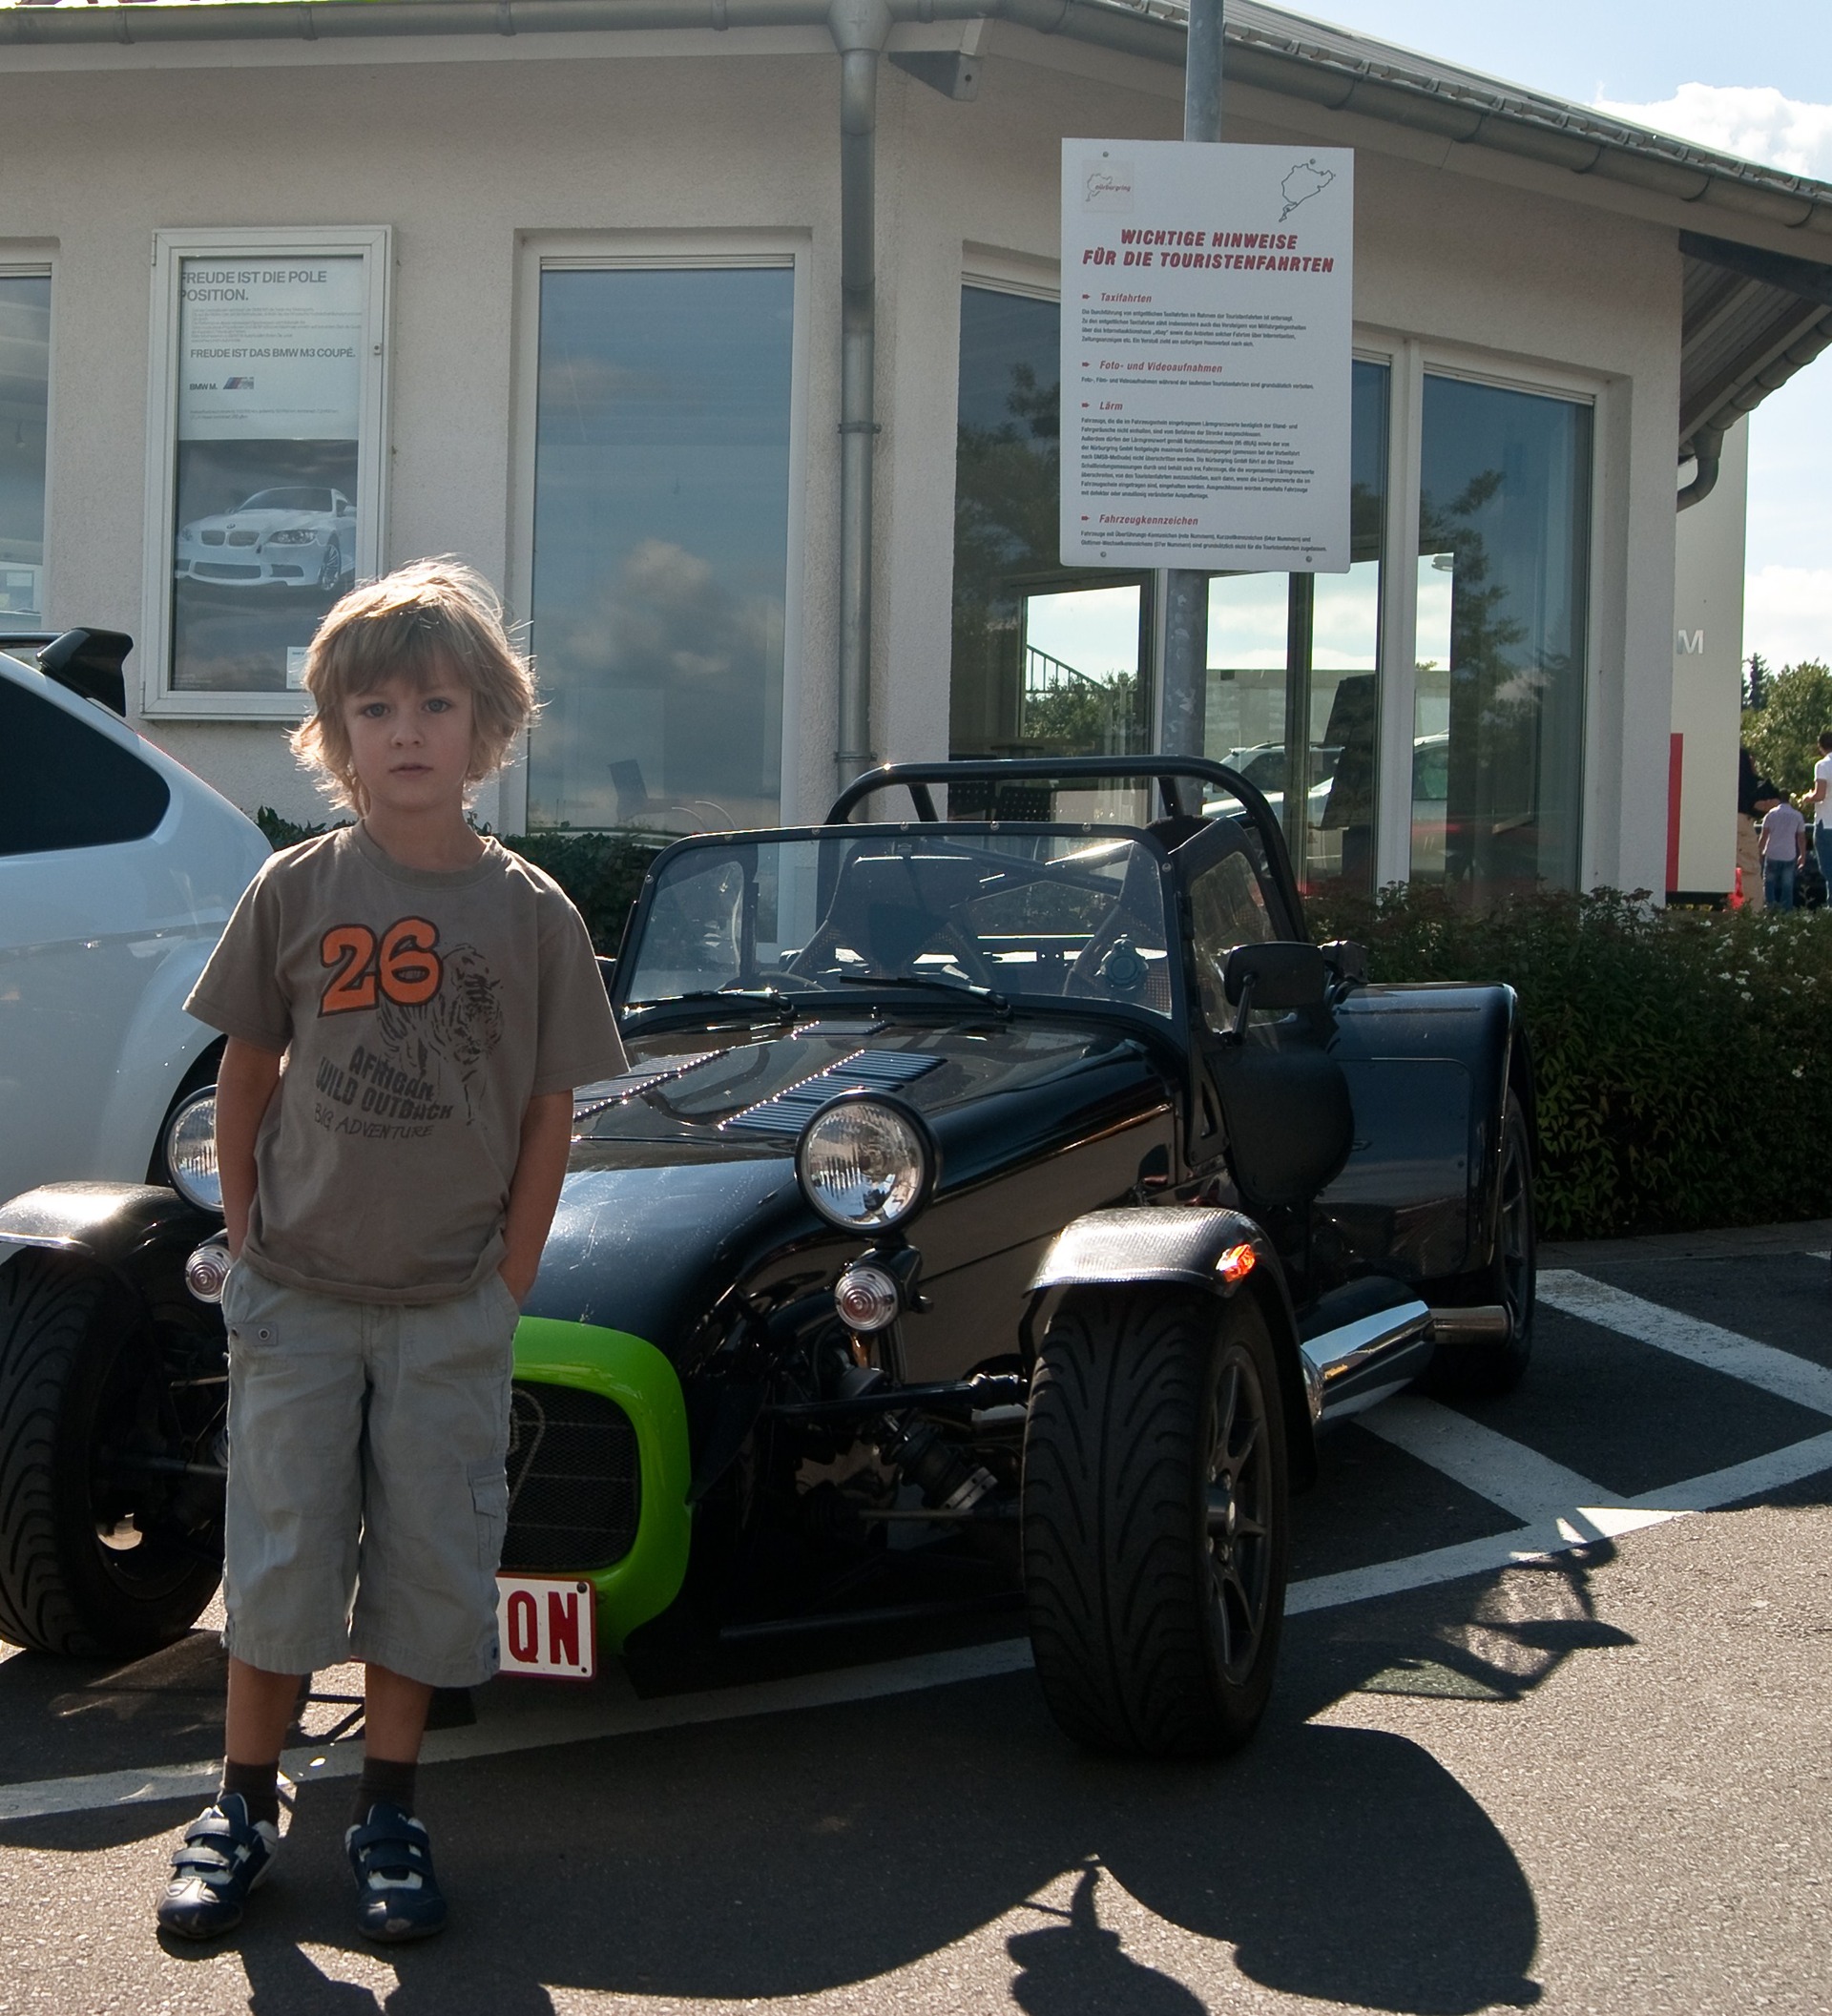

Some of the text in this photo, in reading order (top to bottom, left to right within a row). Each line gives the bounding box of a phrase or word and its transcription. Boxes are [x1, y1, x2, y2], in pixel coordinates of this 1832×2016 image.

[1121, 229, 1298, 250] WICHTIGE HINWEISE
[1082, 247, 1334, 273] FÜR DIE TOURISTENFAHRTEN
[238, 271, 261, 283] IST
[262, 271, 285, 283] DIE
[289, 270, 327, 283] POLE
[1100, 292, 1152, 303] Taxifahrten
[191, 346, 356, 358] FREUDE IST DAS BMW M3 COUPÉ.
[1099, 360, 1222, 373] Foto- und Videoaufnahmen
[1099, 401, 1123, 410] Lärm
[1099, 514, 1198, 526] Fahrzeugkennzeichen
[1676, 630, 1704, 655] M
[317, 915, 444, 1019] 26
[316, 1056, 359, 1106] WILD
[315, 1102, 435, 1140] BIG ADVENTURE
[507, 1590, 580, 1666] QN
